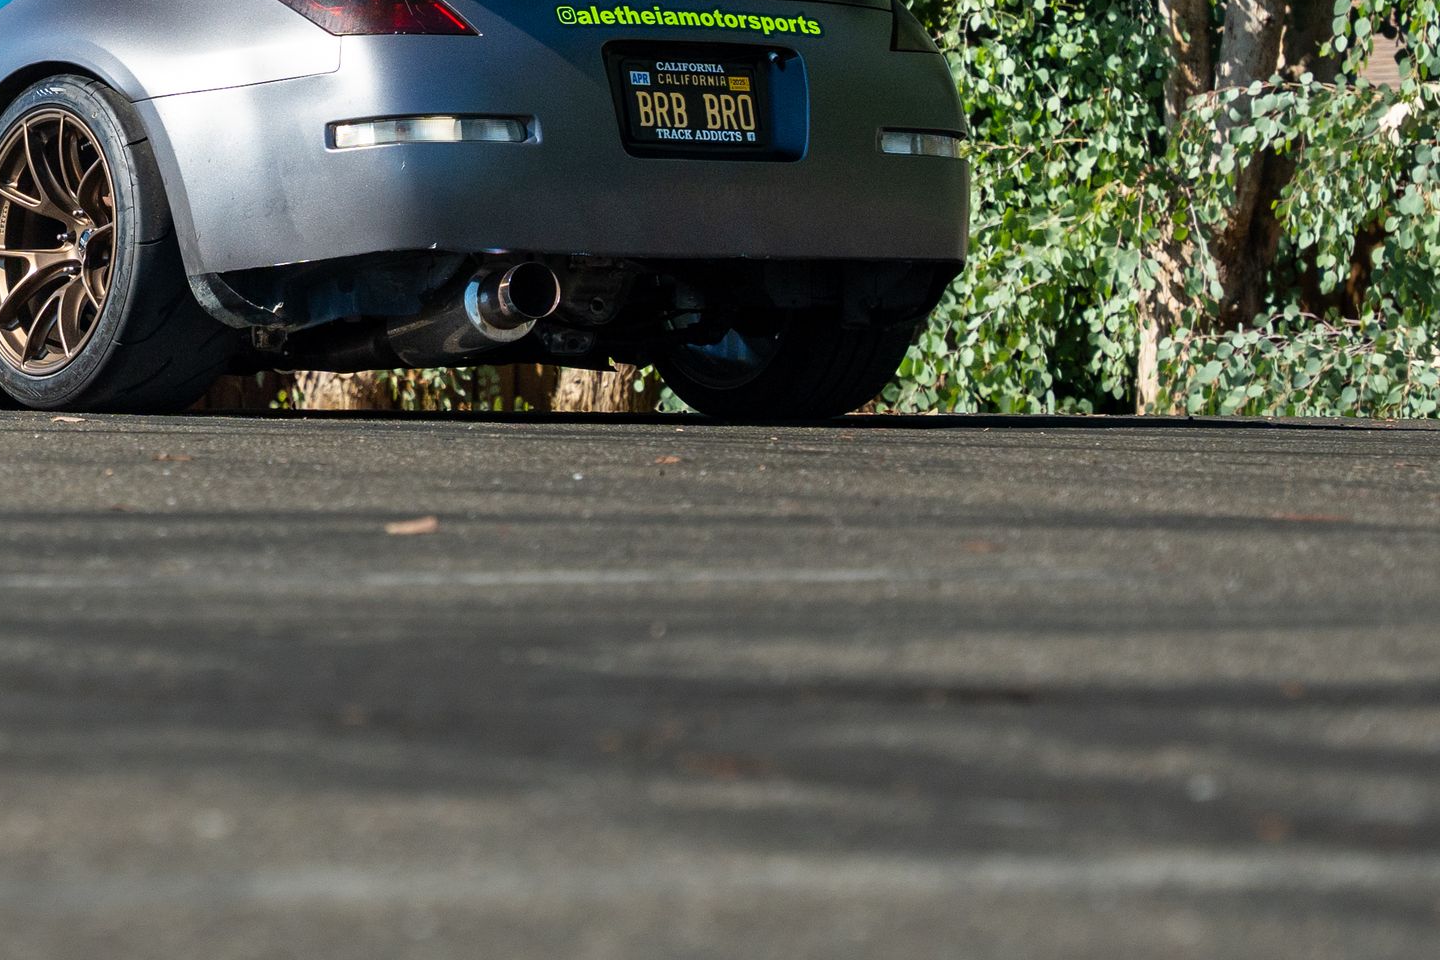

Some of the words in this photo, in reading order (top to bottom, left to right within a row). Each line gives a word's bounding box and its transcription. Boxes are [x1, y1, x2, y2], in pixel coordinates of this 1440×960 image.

[656, 61, 725, 74] CALIFORNIA
[631, 72, 649, 84] APR
[657, 73, 727, 87] CALIFORNIA
[636, 91, 689, 128] BRB
[702, 93, 756, 131] BRO
[656, 128, 693, 141] TRACK
[695, 129, 743, 142] ADDICTS
